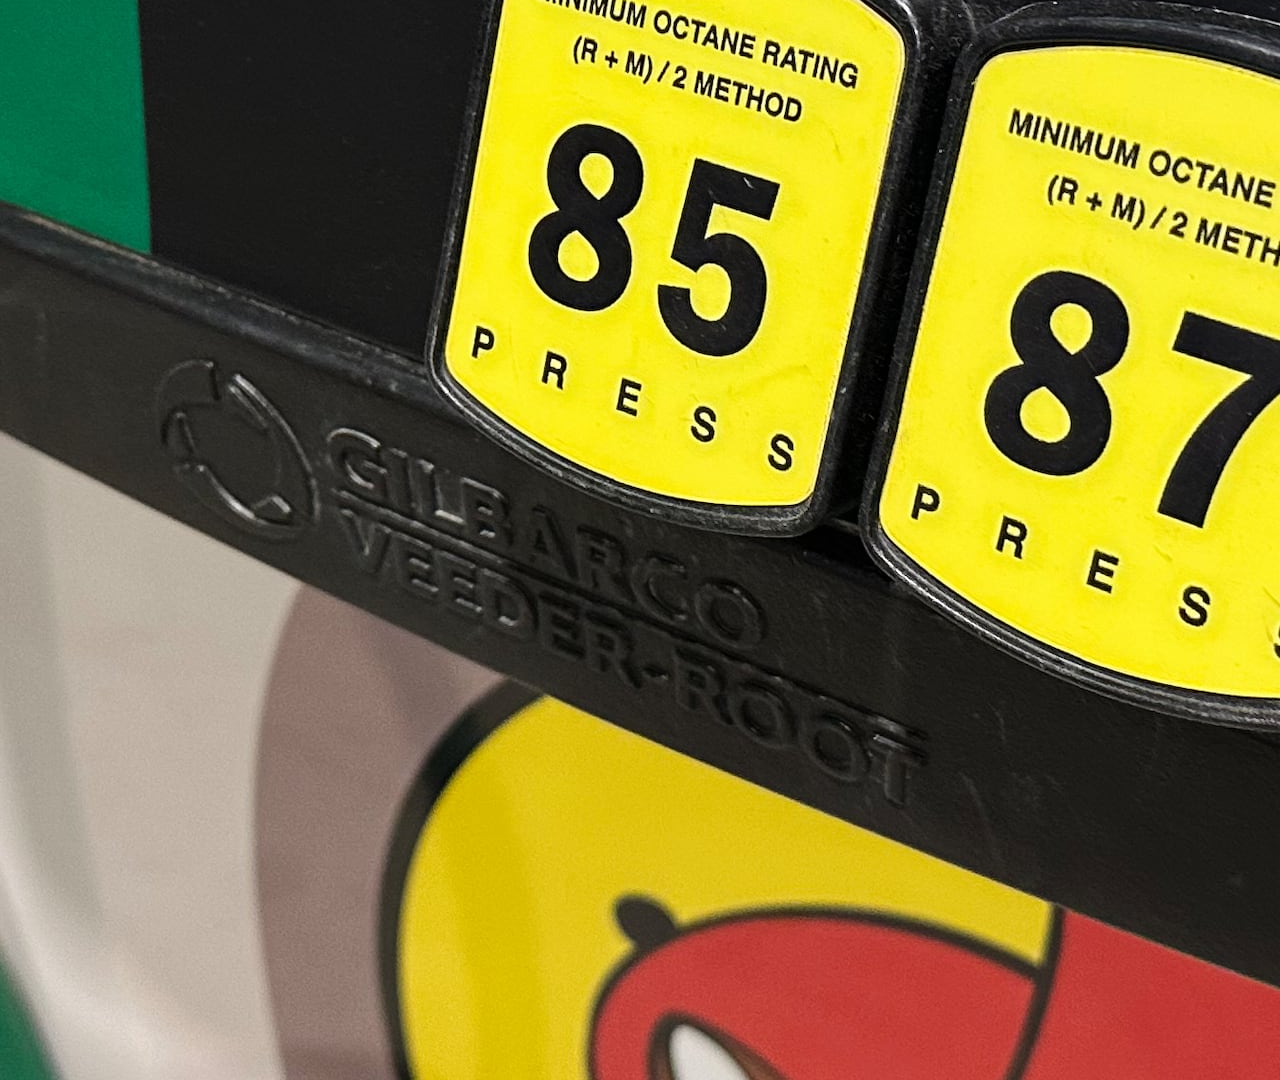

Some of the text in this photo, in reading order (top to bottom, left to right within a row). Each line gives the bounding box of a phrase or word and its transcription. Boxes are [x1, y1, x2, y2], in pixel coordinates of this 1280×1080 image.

[652, 9, 756, 59] OCTANE
[761, 38, 859, 89] RATING
[693, 70, 804, 123] METHOD
[527, 122, 781, 358] 85
[1007, 107, 1142, 169] MINIMUM
[1147, 148, 1277, 209] OCTANE
[325, 425, 767, 652] GILBARCO
[334, 503, 928, 808] VEEDER-ROOT
